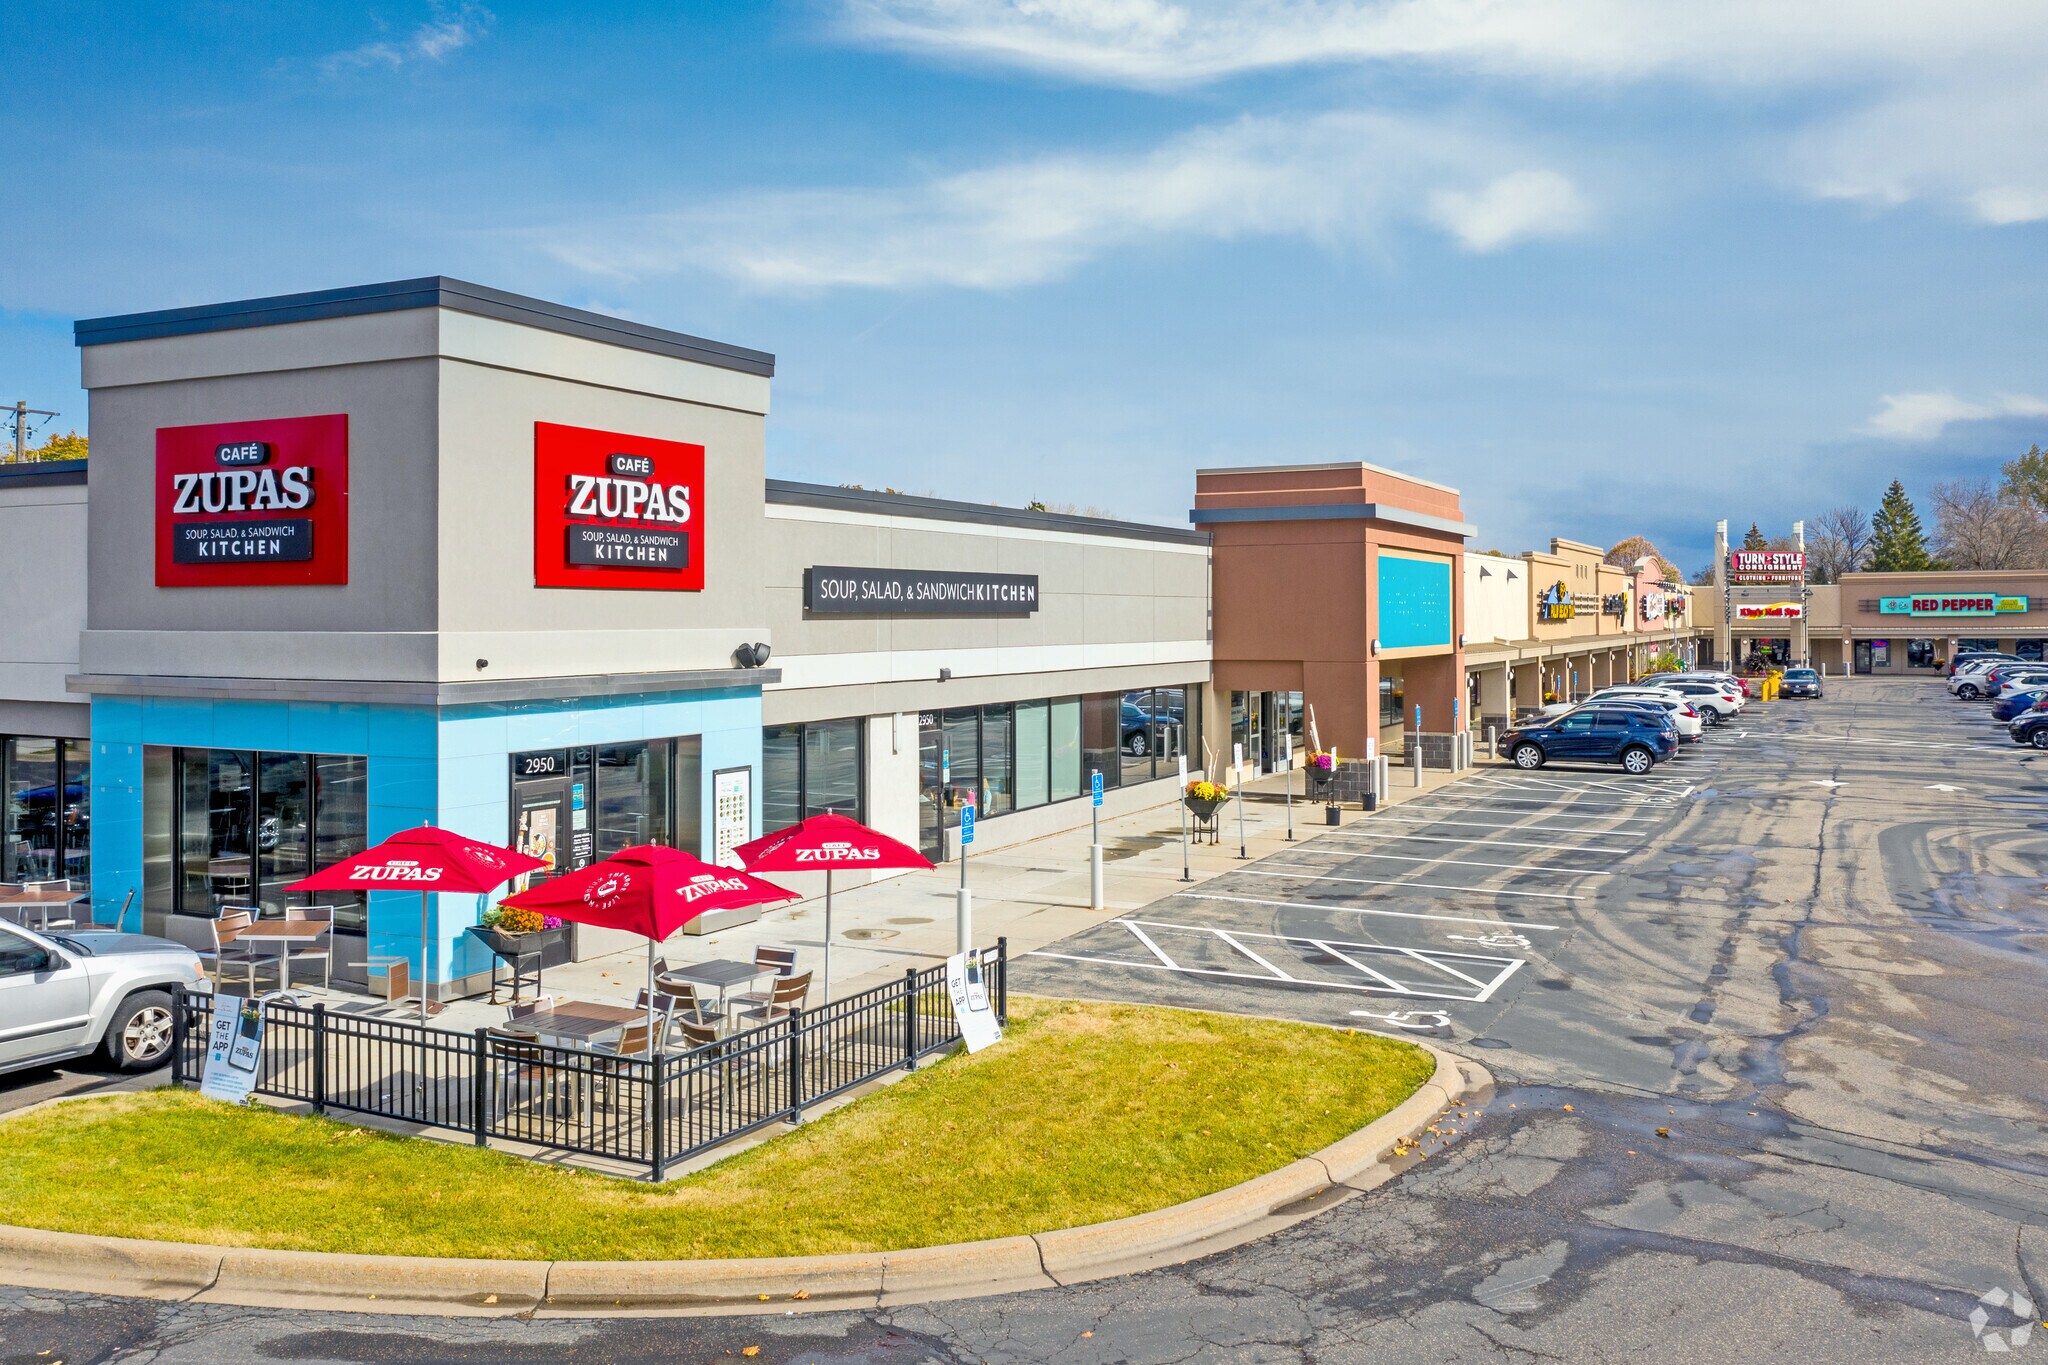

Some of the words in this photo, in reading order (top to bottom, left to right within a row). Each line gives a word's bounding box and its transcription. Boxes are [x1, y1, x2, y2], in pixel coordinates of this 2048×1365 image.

[220, 443, 258, 462] CAFÉ
[616, 457, 650, 474] CAFÉ
[173, 466, 310, 514] ZUPAS
[570, 474, 691, 524] ZUPAS
[185, 529, 209, 540] SOUP,
[210, 528, 239, 539] SALAD,
[241, 530, 247, 538] &
[248, 526, 295, 538] SANDWICH
[582, 531, 605, 543] SOUP,
[606, 532, 633, 544] SALAD,
[640, 535, 679, 546] SANDWICH
[199, 539, 280, 557] KITCHEN
[595, 544, 668, 562] KITCHEN
[1739, 553, 1766, 564] TURN
[1772, 553, 1803, 564] STYLE
[820, 579, 858, 601] SOUP,
[861, 580, 904, 602] SALAD,
[906, 585, 914, 600] &
[1912, 599, 1939, 611] RED
[1942, 598, 1994, 611] PEPPER
[918, 714, 934, 726] 2950
[525, 756, 555, 774] 2950
[795, 847, 881, 862] ZUPAS
[348, 864, 444, 882] ZUPAS
[675, 877, 749, 903] ZUPAS
[951, 978, 961, 988] GET
[216, 1020, 231, 1031] GET
[216, 1031, 229, 1041] THE
[213, 1041, 229, 1052] APP
